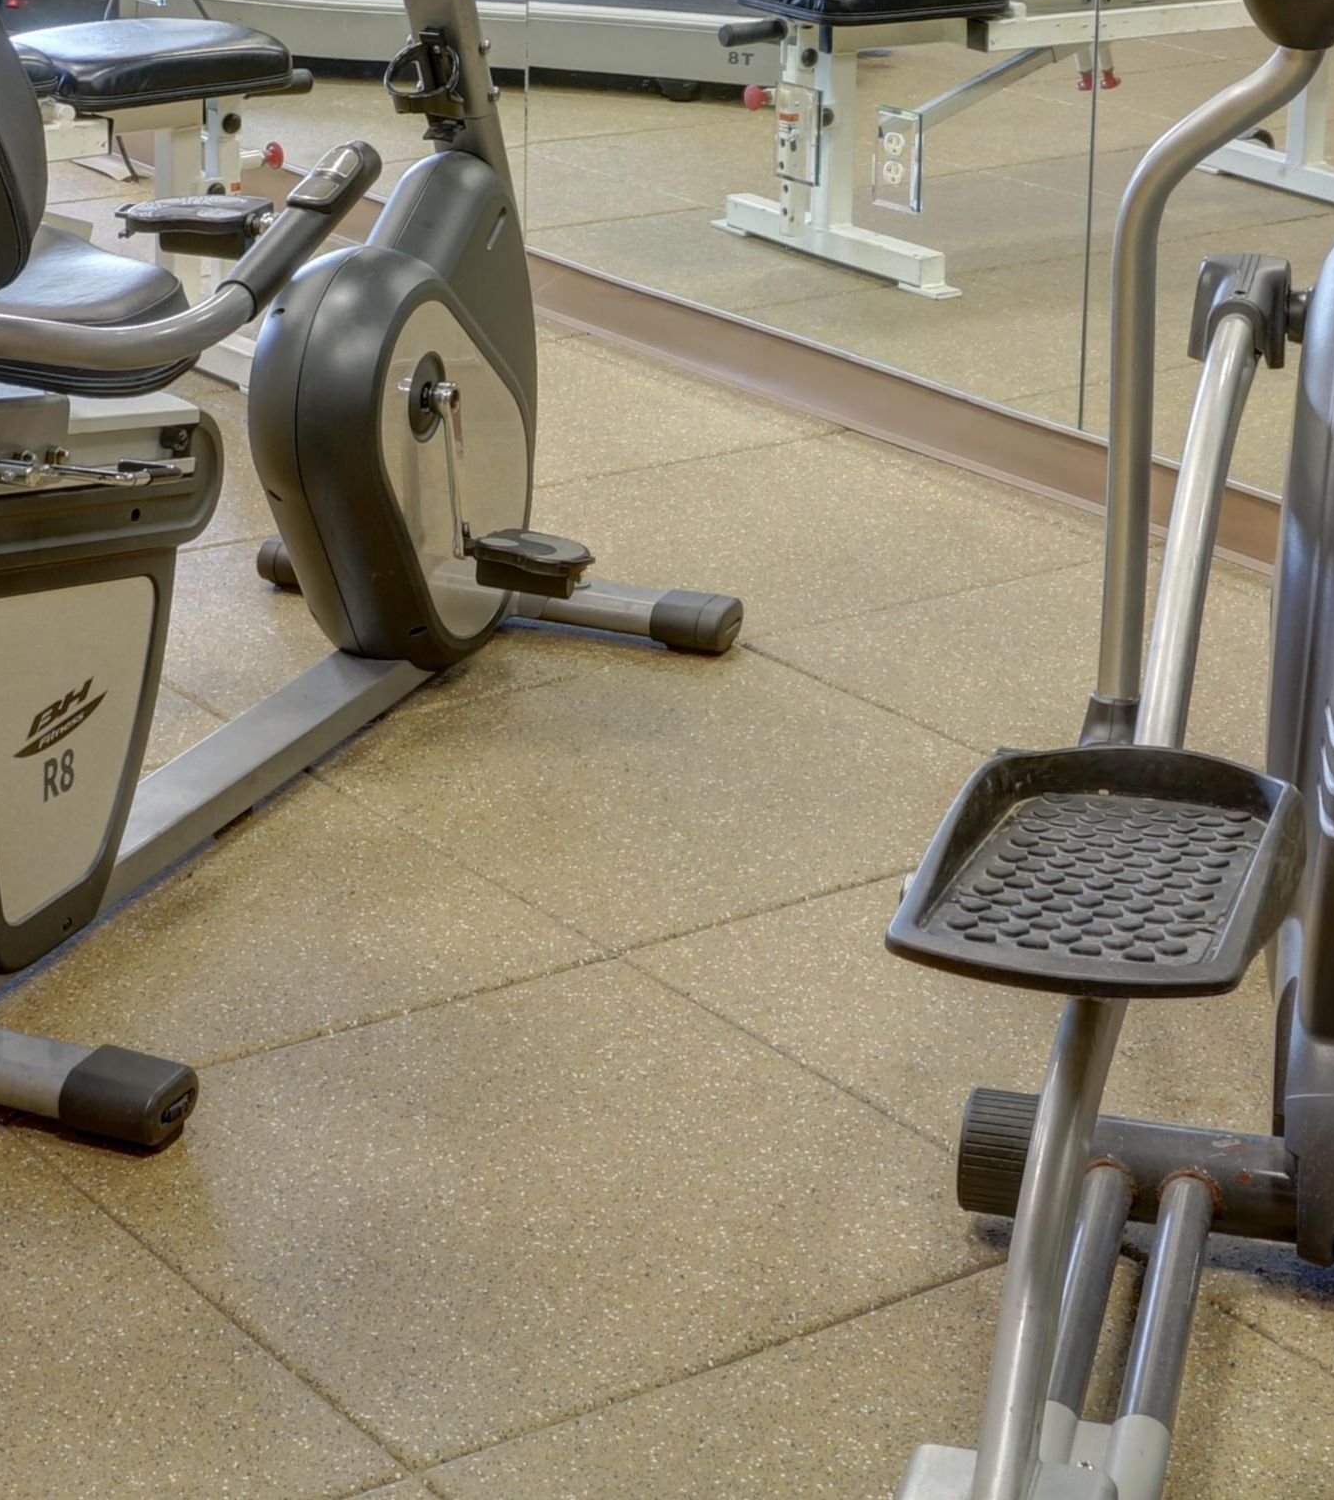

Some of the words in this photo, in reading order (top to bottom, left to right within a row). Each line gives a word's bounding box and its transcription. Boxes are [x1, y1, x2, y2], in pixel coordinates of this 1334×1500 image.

[26, 676, 94, 740] BH
[38, 711, 85, 749] Fitness
[43, 748, 74, 803] R8
